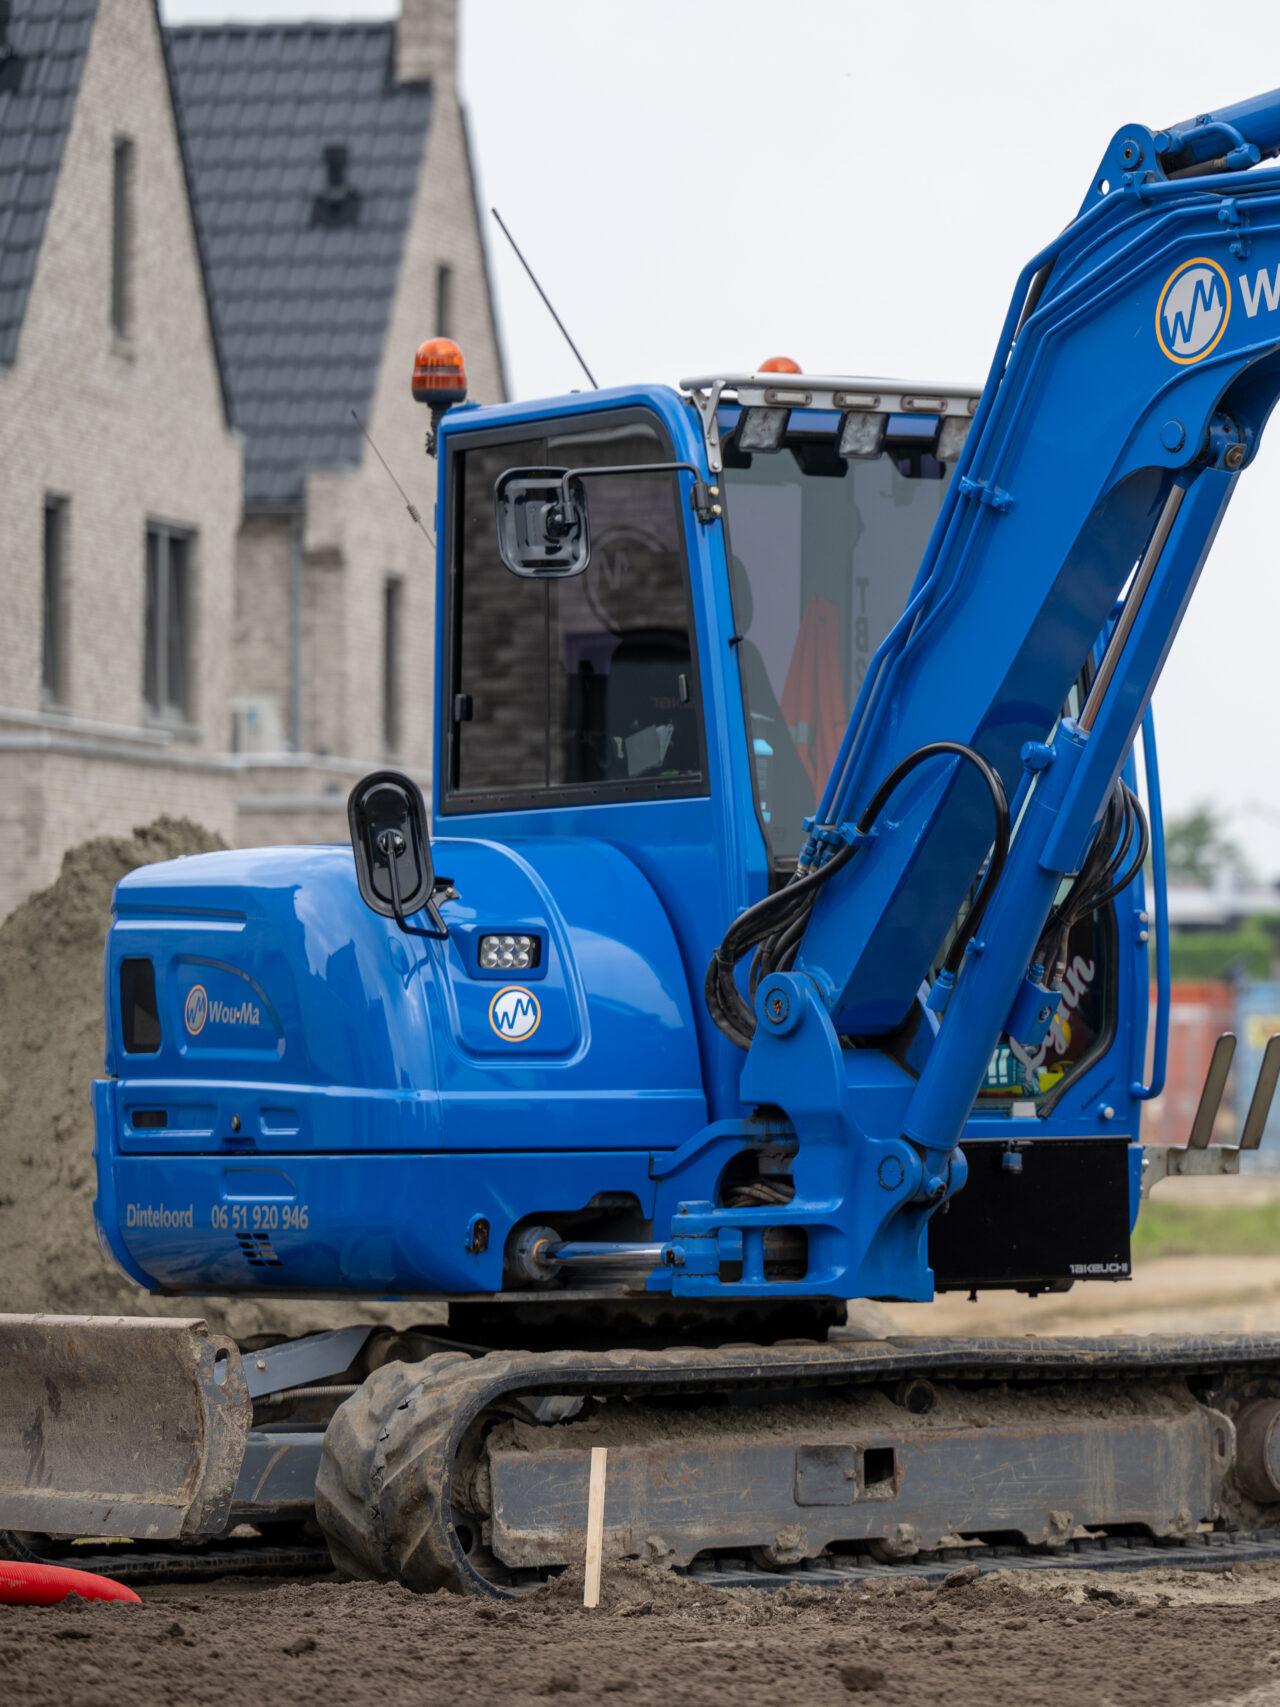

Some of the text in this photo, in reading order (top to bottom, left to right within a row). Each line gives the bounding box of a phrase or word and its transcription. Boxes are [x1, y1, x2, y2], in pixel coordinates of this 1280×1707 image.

[126, 1203, 309, 1230] Dinteloord 06 51 920 946
